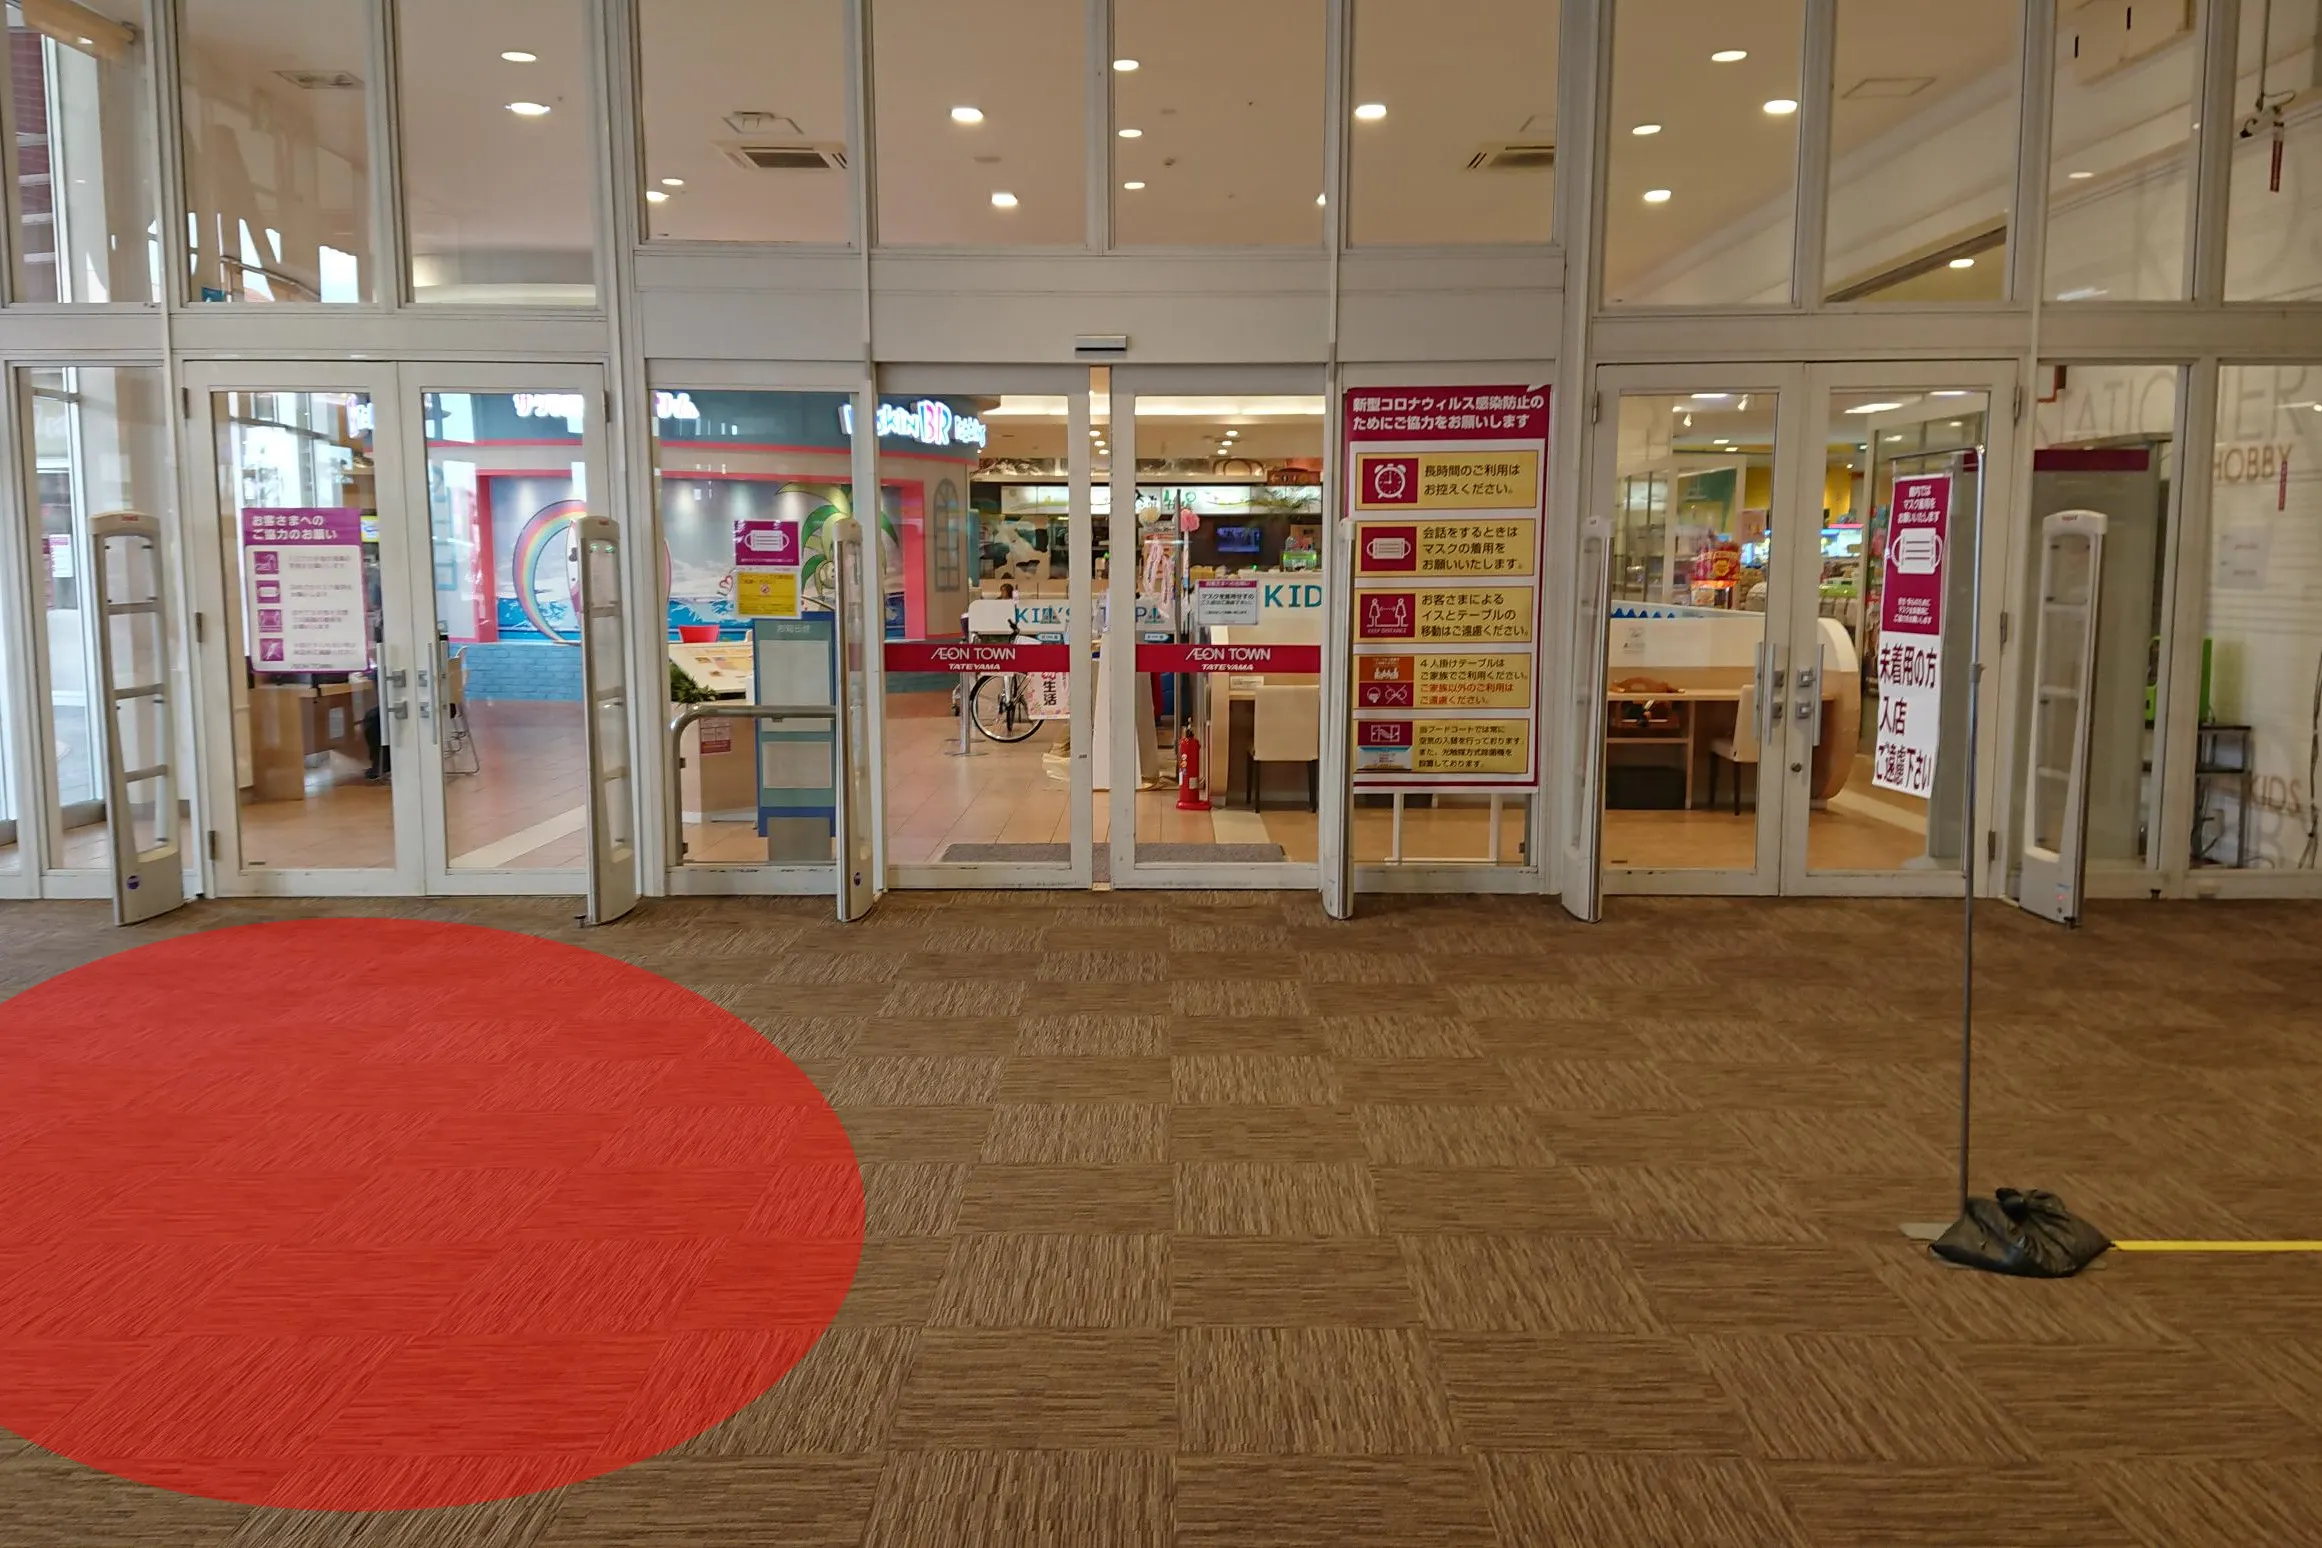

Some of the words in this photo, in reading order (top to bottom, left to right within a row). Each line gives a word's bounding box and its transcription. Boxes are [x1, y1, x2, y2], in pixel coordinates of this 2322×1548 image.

[1353, 395, 1544, 413] 新型コロナウィルス感染防止の
[1353, 414, 1530, 431] ためにご協力をお願いします
[1424, 463, 1521, 478] 長時間のご利用は
[1424, 483, 1514, 496] お控えください。
[251, 515, 325, 526] お客さまへの
[251, 529, 338, 541] ご協力のお願い
[1423, 526, 1519, 540] 会話をするときは
[1423, 542, 1506, 555] マスクの着用を
[1422, 558, 1524, 571] お願いいたします。
[1421, 593, 1505, 606] お客さまによる
[1421, 609, 1517, 622] イスとテーブルの
[1420, 624, 1529, 637] 移動はご遠慮ください。
[975, 648, 1016, 661] TOWN
[1229, 648, 1271, 661] TOWN
[948, 663, 1001, 671] TATEYAMA
[1202, 663, 1254, 671] TATEYAMA
[1880, 642, 1938, 689] 未着用の方
[1420, 670, 1528, 681] ご家族でご利用ください。
[1420, 683, 1514, 693] ご家族以外のご利用は
[1420, 695, 1489, 705] ご遠慮ください。
[1879, 696, 1908, 737] 入店
[1876, 741, 1932, 790] ご遠慮下さい
